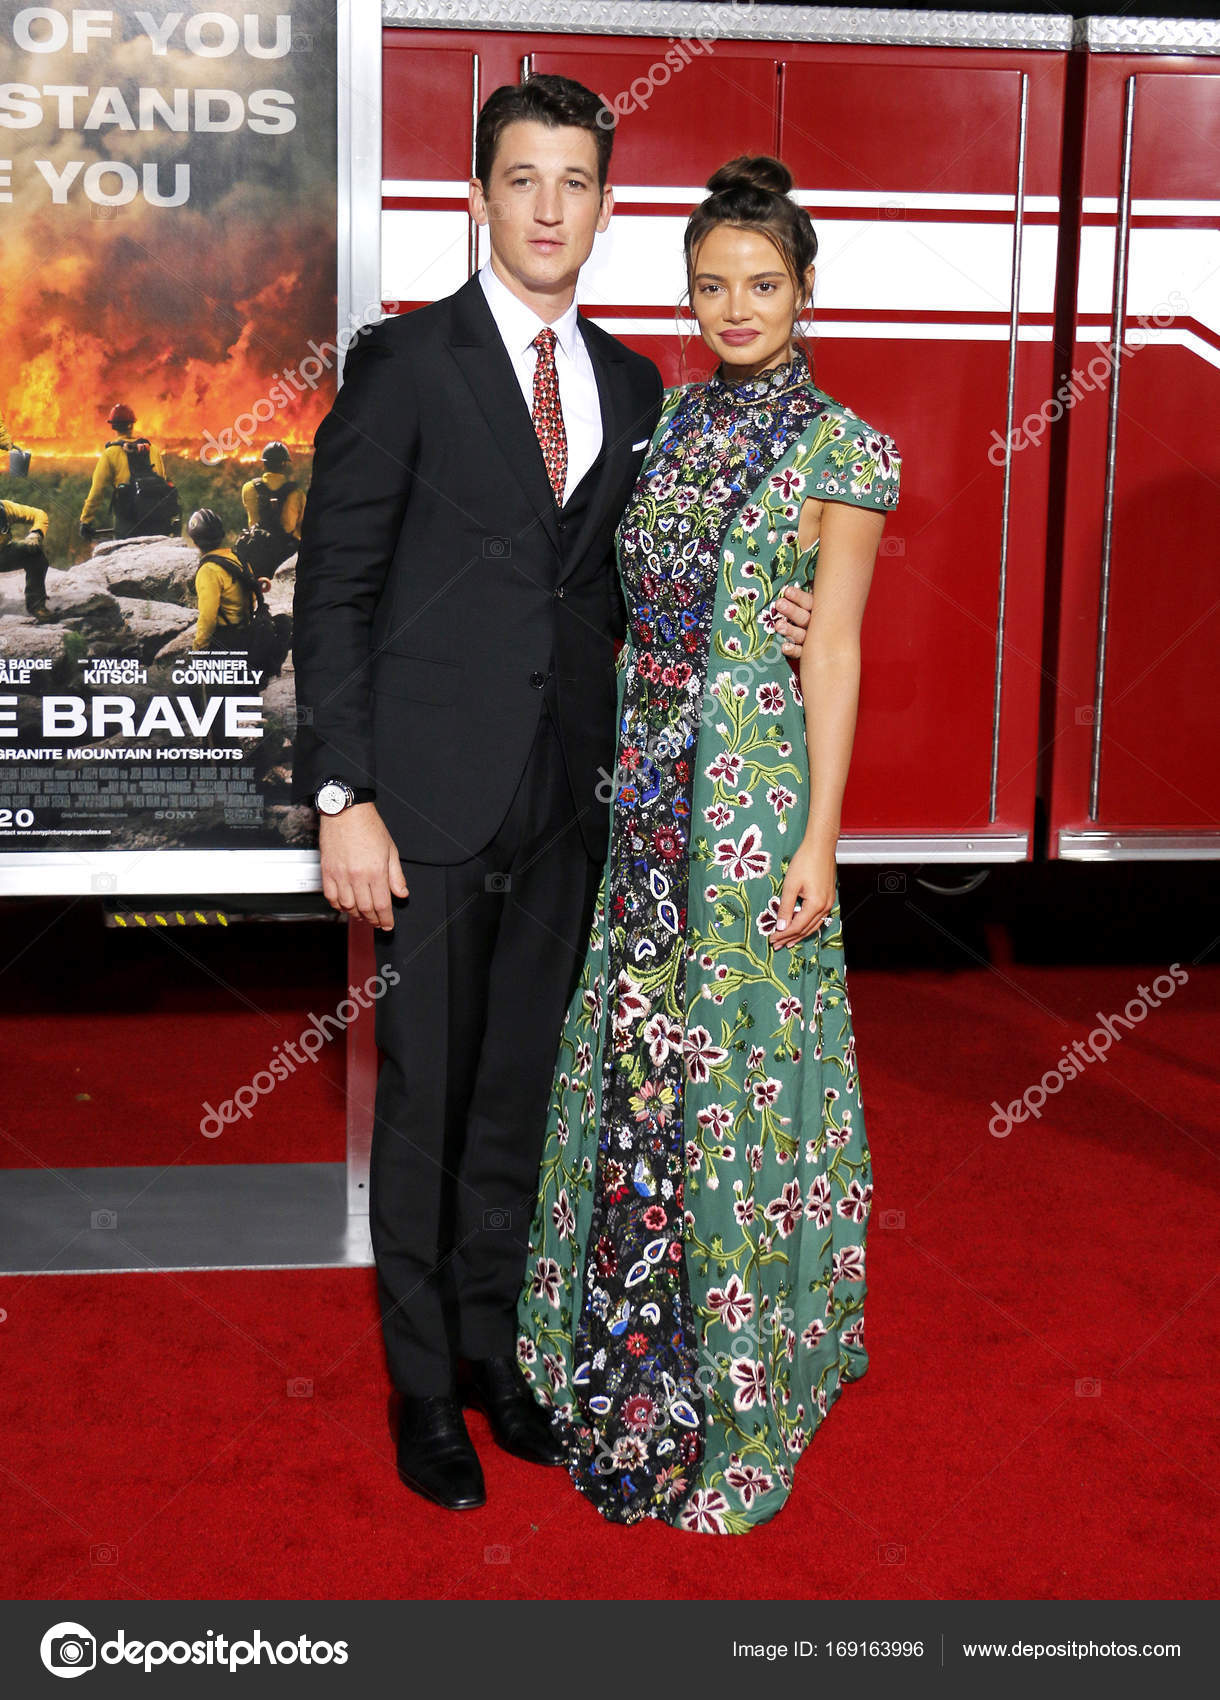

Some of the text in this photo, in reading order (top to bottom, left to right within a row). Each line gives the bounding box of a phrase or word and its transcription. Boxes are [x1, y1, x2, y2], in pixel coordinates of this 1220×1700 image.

[12, 7, 292, 59] OF YOU
[0, 82, 297, 135] STANDS
[34, 160, 191, 208] YOU
[9, 659, 53, 670] BADGE
[92, 659, 139, 670] TAYLOR
[188, 659, 247, 671] JENNIFER
[0, 670, 31, 684] ALE
[84, 670, 147, 684] KITSCH
[172, 670, 264, 685] CONNELLY
[42, 696, 264, 737] BRAVE
[67, 748, 151, 760] MOUNTAIN
[156, 748, 243, 760] HOTSHOTS
[0, 808, 35, 828] 20
[154, 811, 197, 820] SONY
